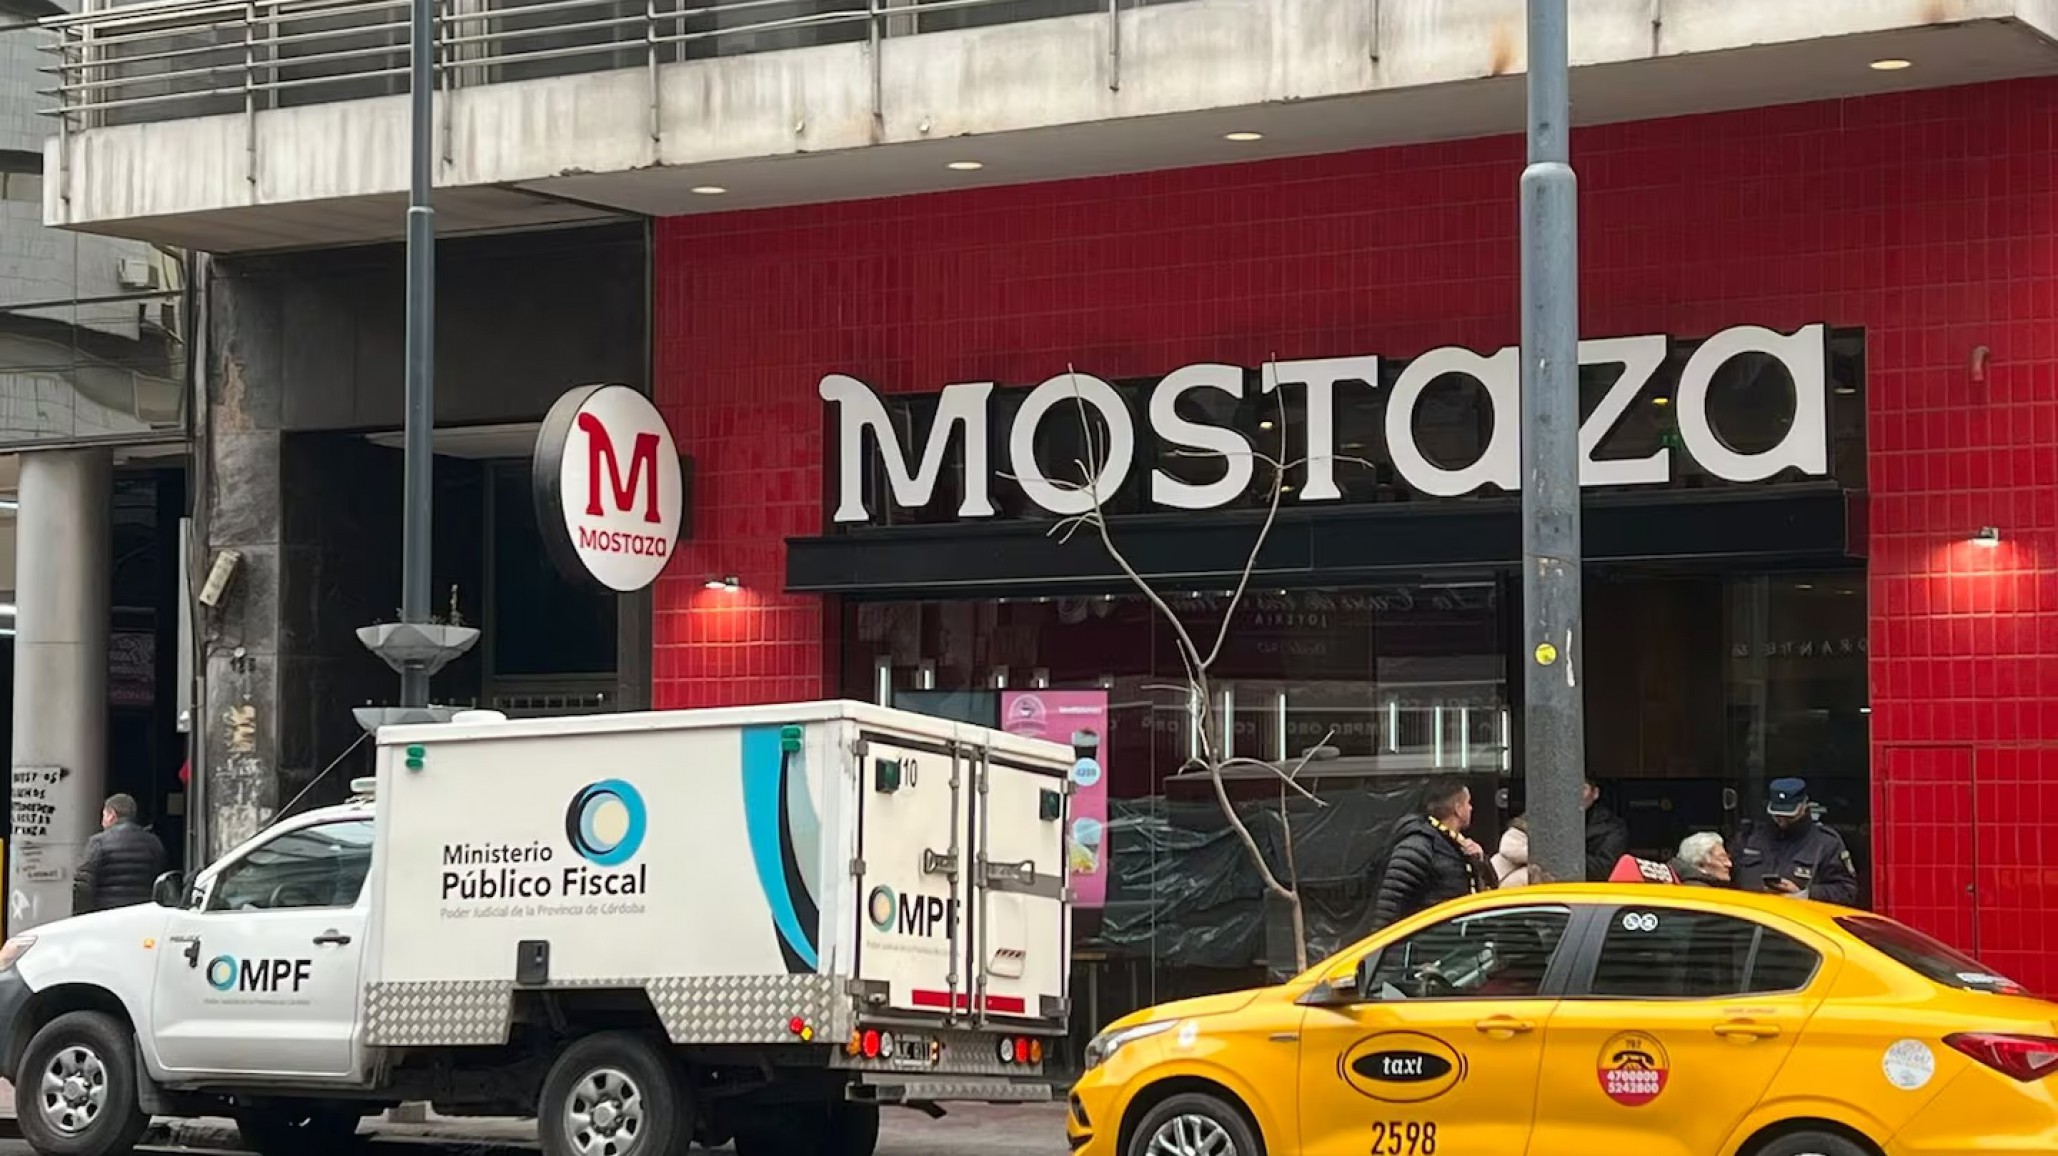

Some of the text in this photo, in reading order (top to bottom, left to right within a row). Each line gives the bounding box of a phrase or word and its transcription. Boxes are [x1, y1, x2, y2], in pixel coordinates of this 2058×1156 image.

[443, 840, 553, 865] Ministerio
[442, 863, 647, 900] Público Fiscal
[441, 902, 646, 920] Poder Judicial de la Provincia de Córdoba
[1383, 1056, 1423, 1075] taxi
[1371, 1121, 1437, 1156] 2598
